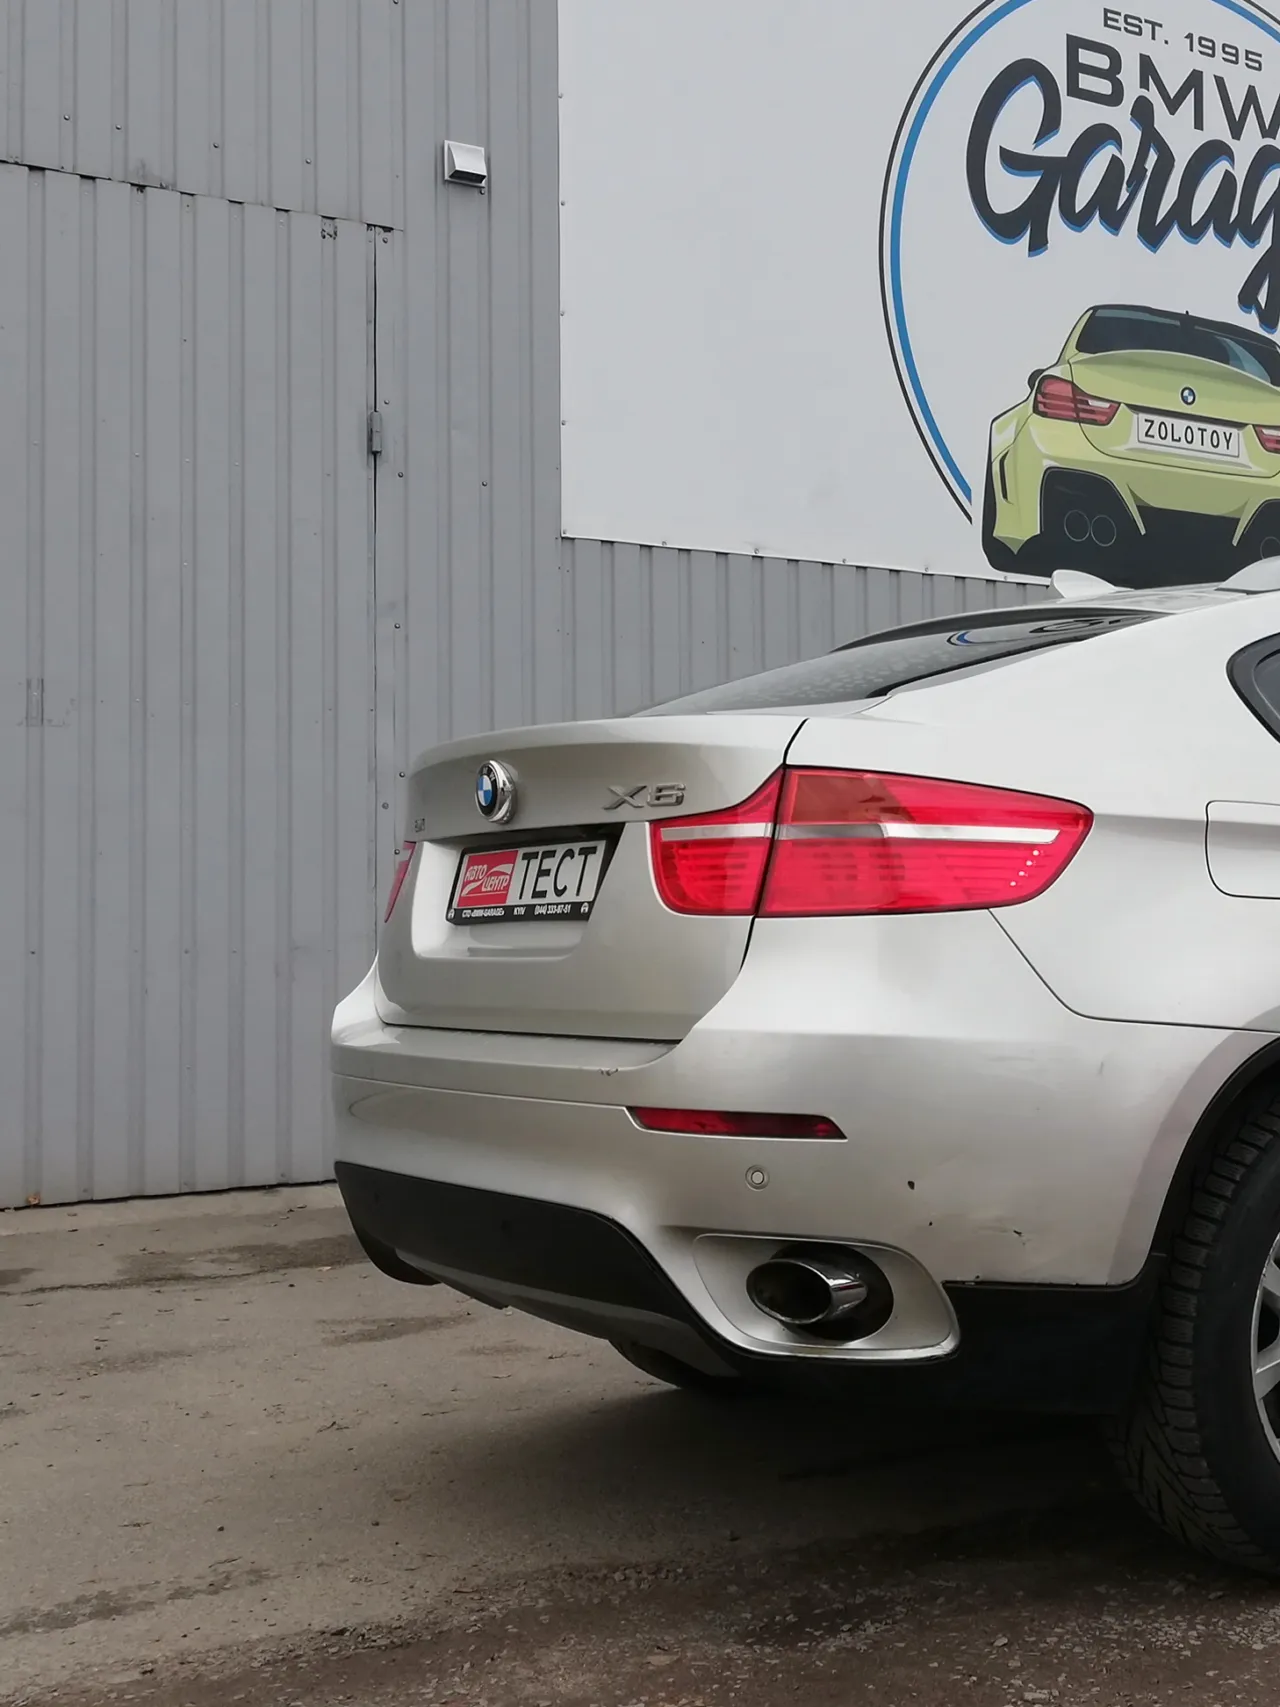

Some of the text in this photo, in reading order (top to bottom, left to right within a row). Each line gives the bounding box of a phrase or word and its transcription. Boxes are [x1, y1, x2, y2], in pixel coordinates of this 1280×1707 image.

[1103, 7, 1263, 72] EST. 1995
[1144, 418, 1233, 450] ZOLOTOY
[602, 783, 686, 811] X6
[464, 864, 488, 882] АВТО
[481, 875, 510, 892] ЦЕНТР
[518, 846, 598, 900] ТЕСТ
